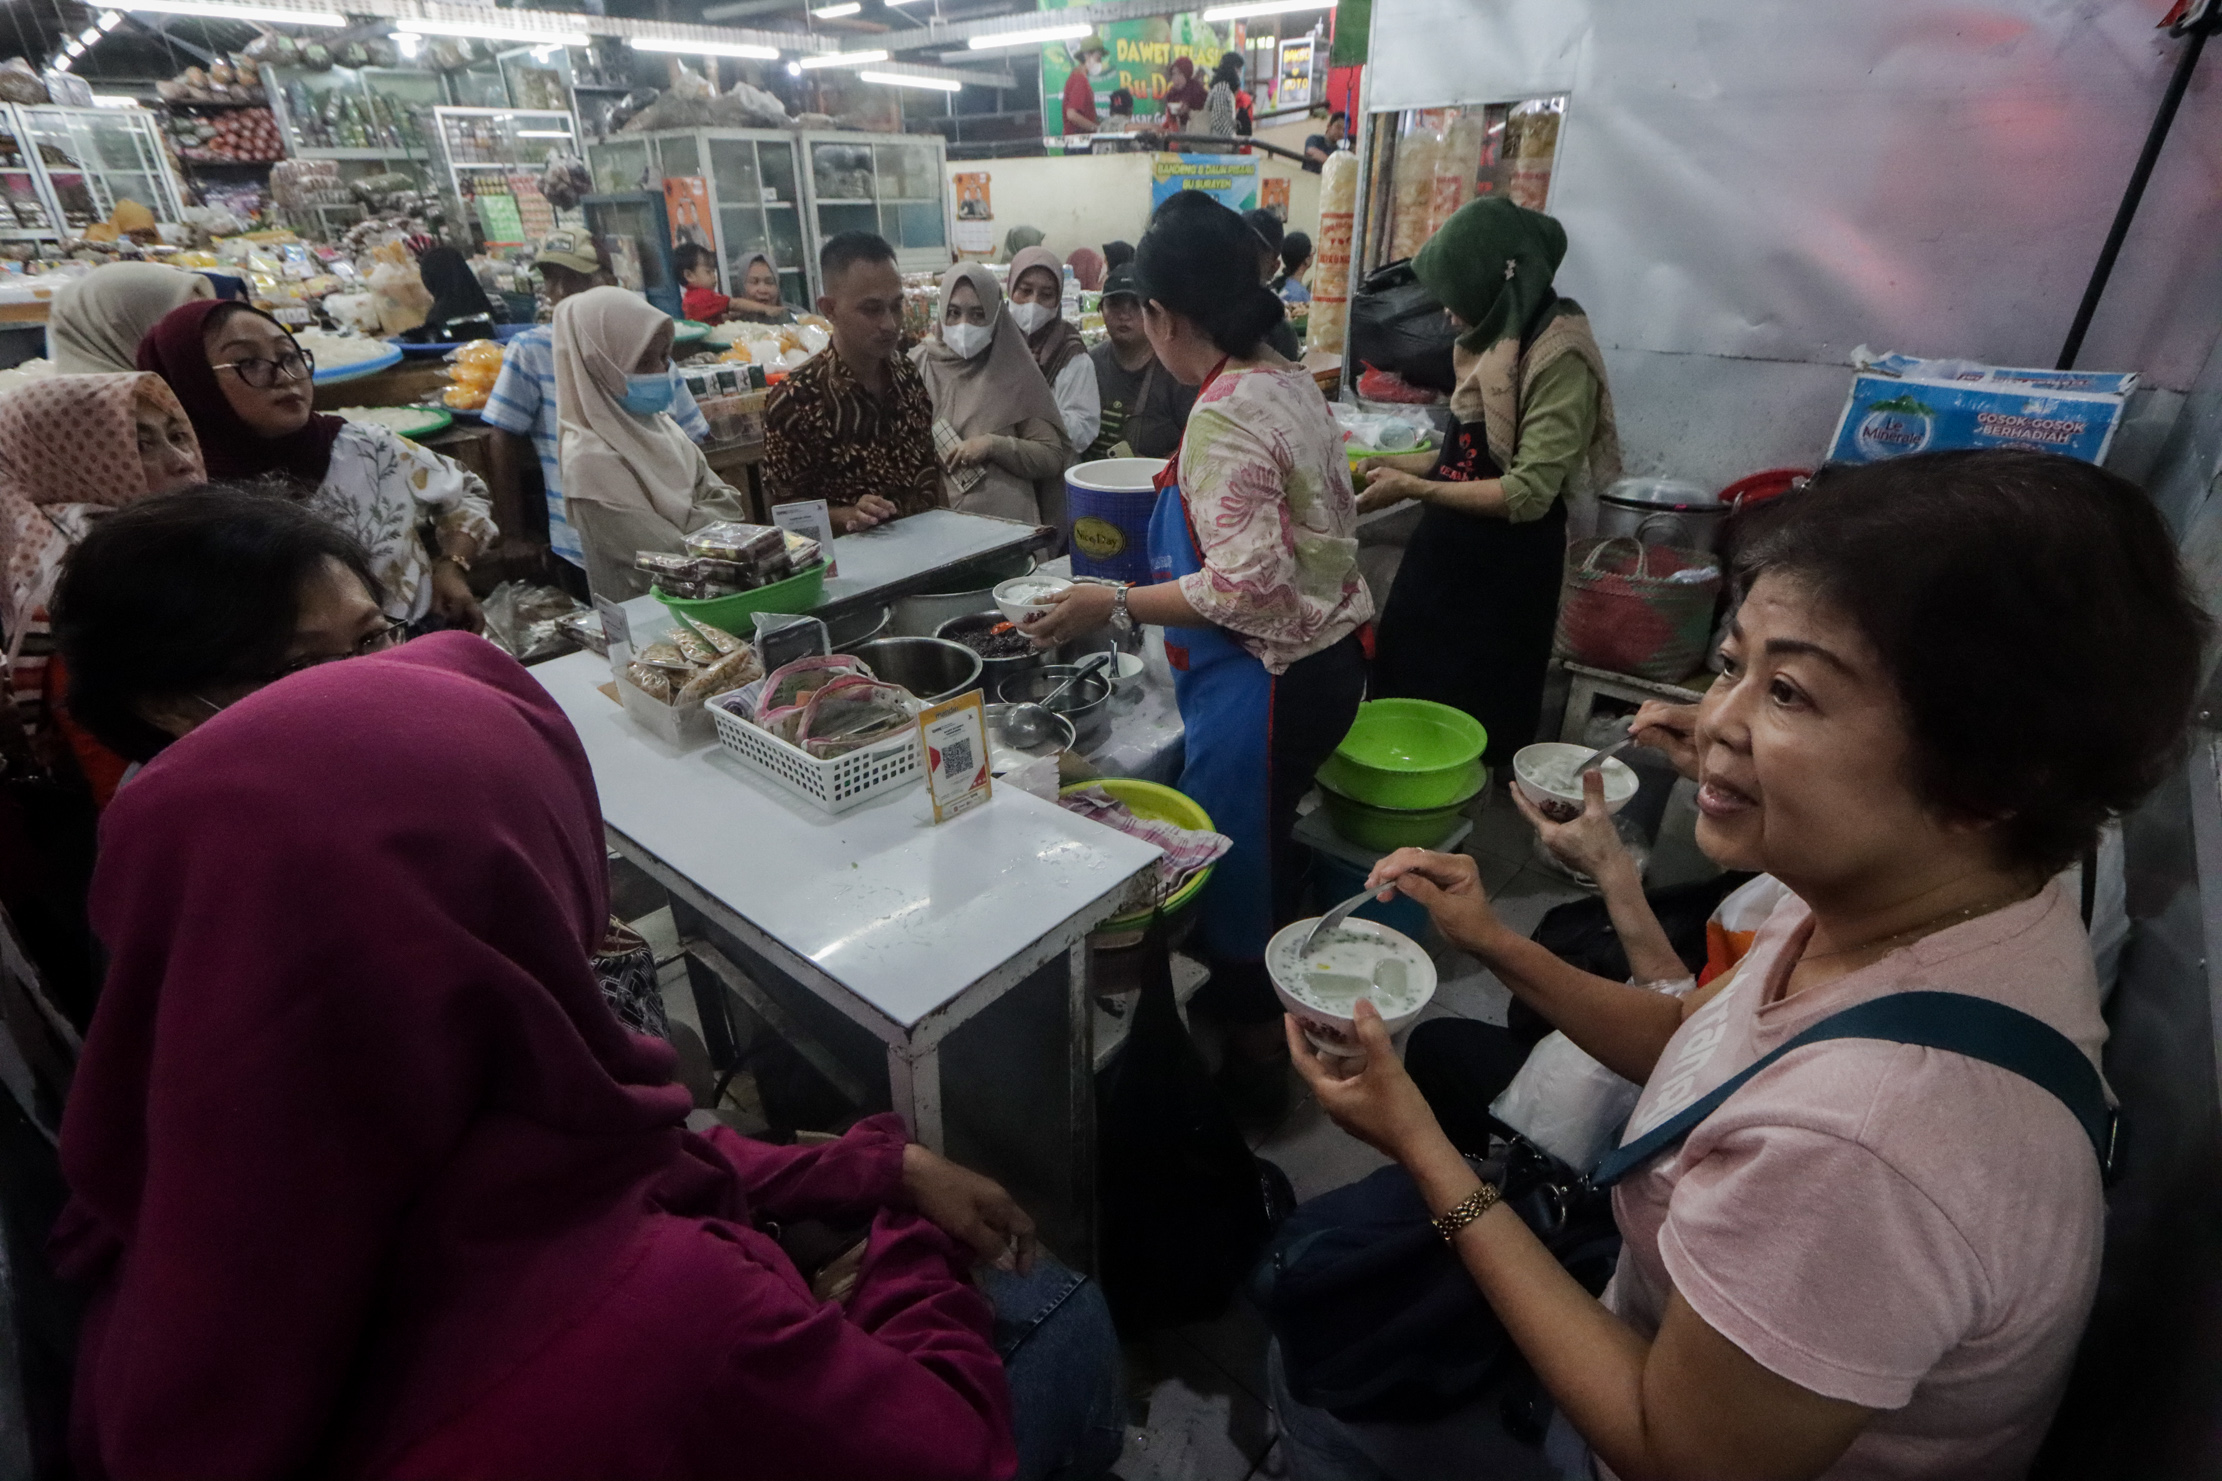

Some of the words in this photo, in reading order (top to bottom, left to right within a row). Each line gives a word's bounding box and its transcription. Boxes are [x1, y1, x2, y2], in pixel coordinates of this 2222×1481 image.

[1116, 38, 1170, 65] DAWET
[1886, 417, 1903, 431] Le
[1977, 413, 2087, 433] GOSOK-GOSOK
[1863, 425, 1922, 445] Minerale
[1983, 425, 2070, 444] BERHADIAH
